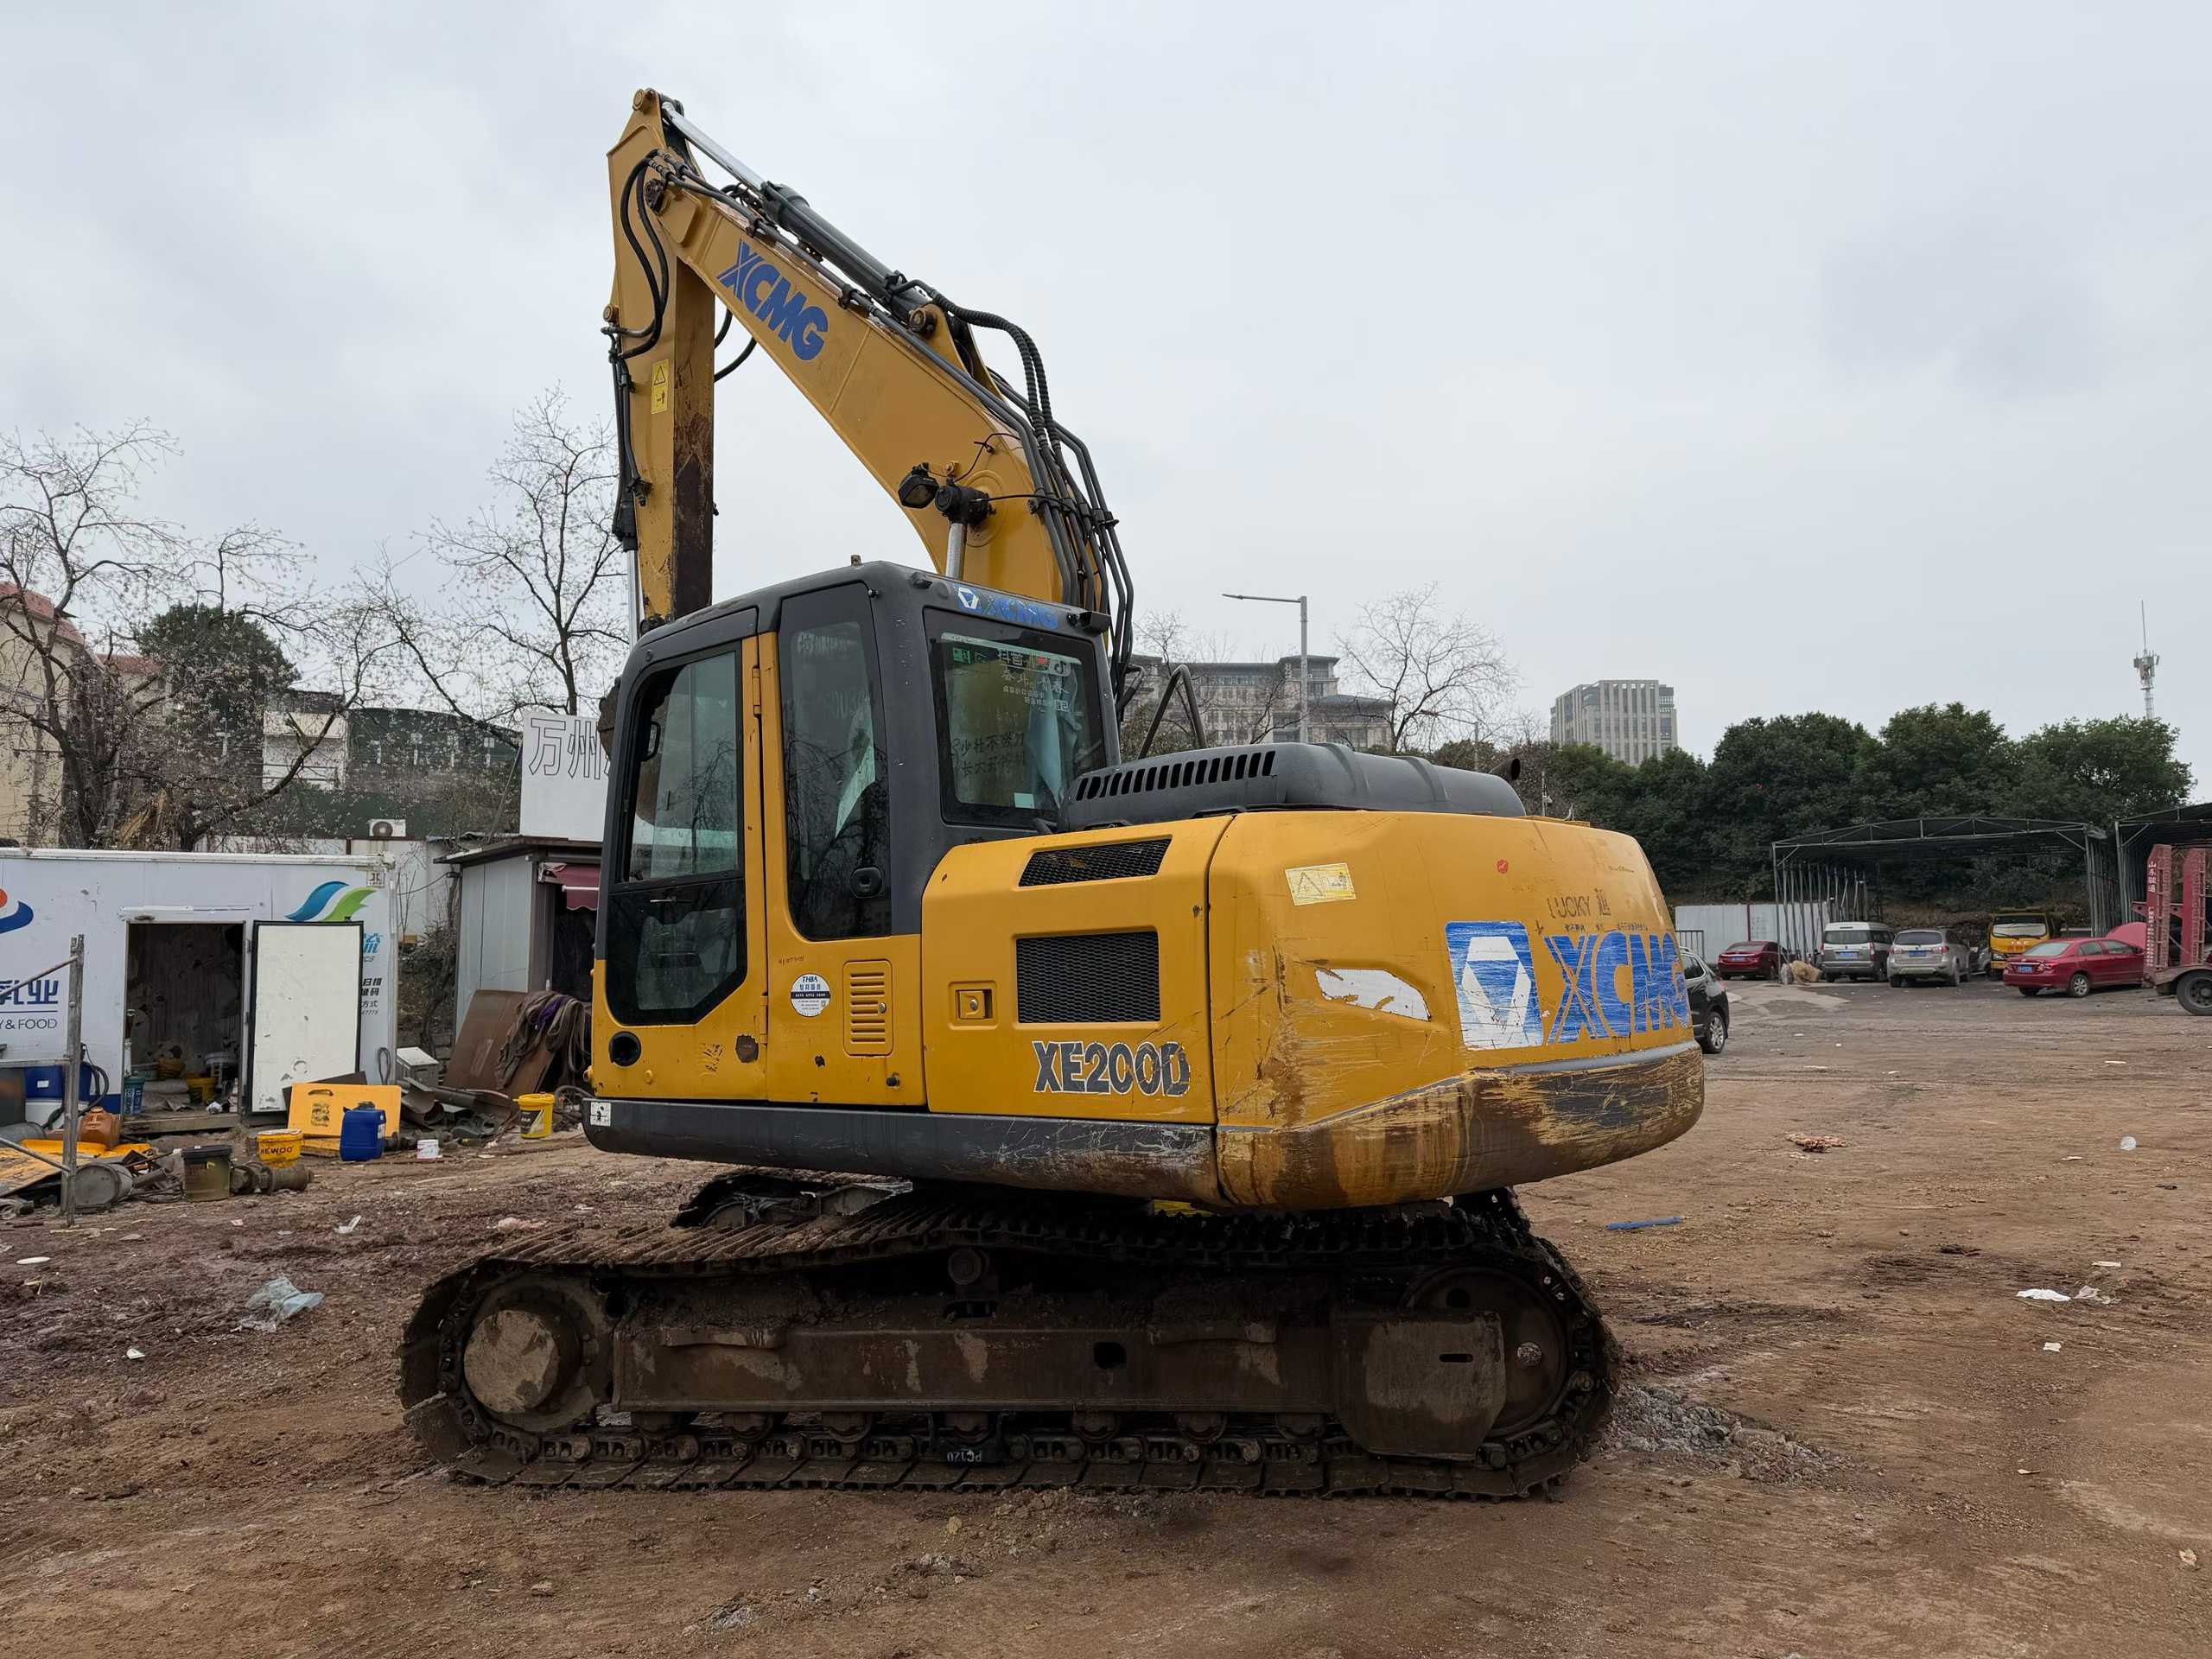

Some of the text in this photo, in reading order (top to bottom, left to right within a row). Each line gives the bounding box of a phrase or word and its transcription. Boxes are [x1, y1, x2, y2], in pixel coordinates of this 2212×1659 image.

[716, 239, 829, 361] XCMG
[529, 717, 611, 780] 万州
[1543, 931, 1692, 1044] XCMG
[18, 1018, 58, 1030] FOOD
[1032, 1040, 1191, 1097] XE200D
